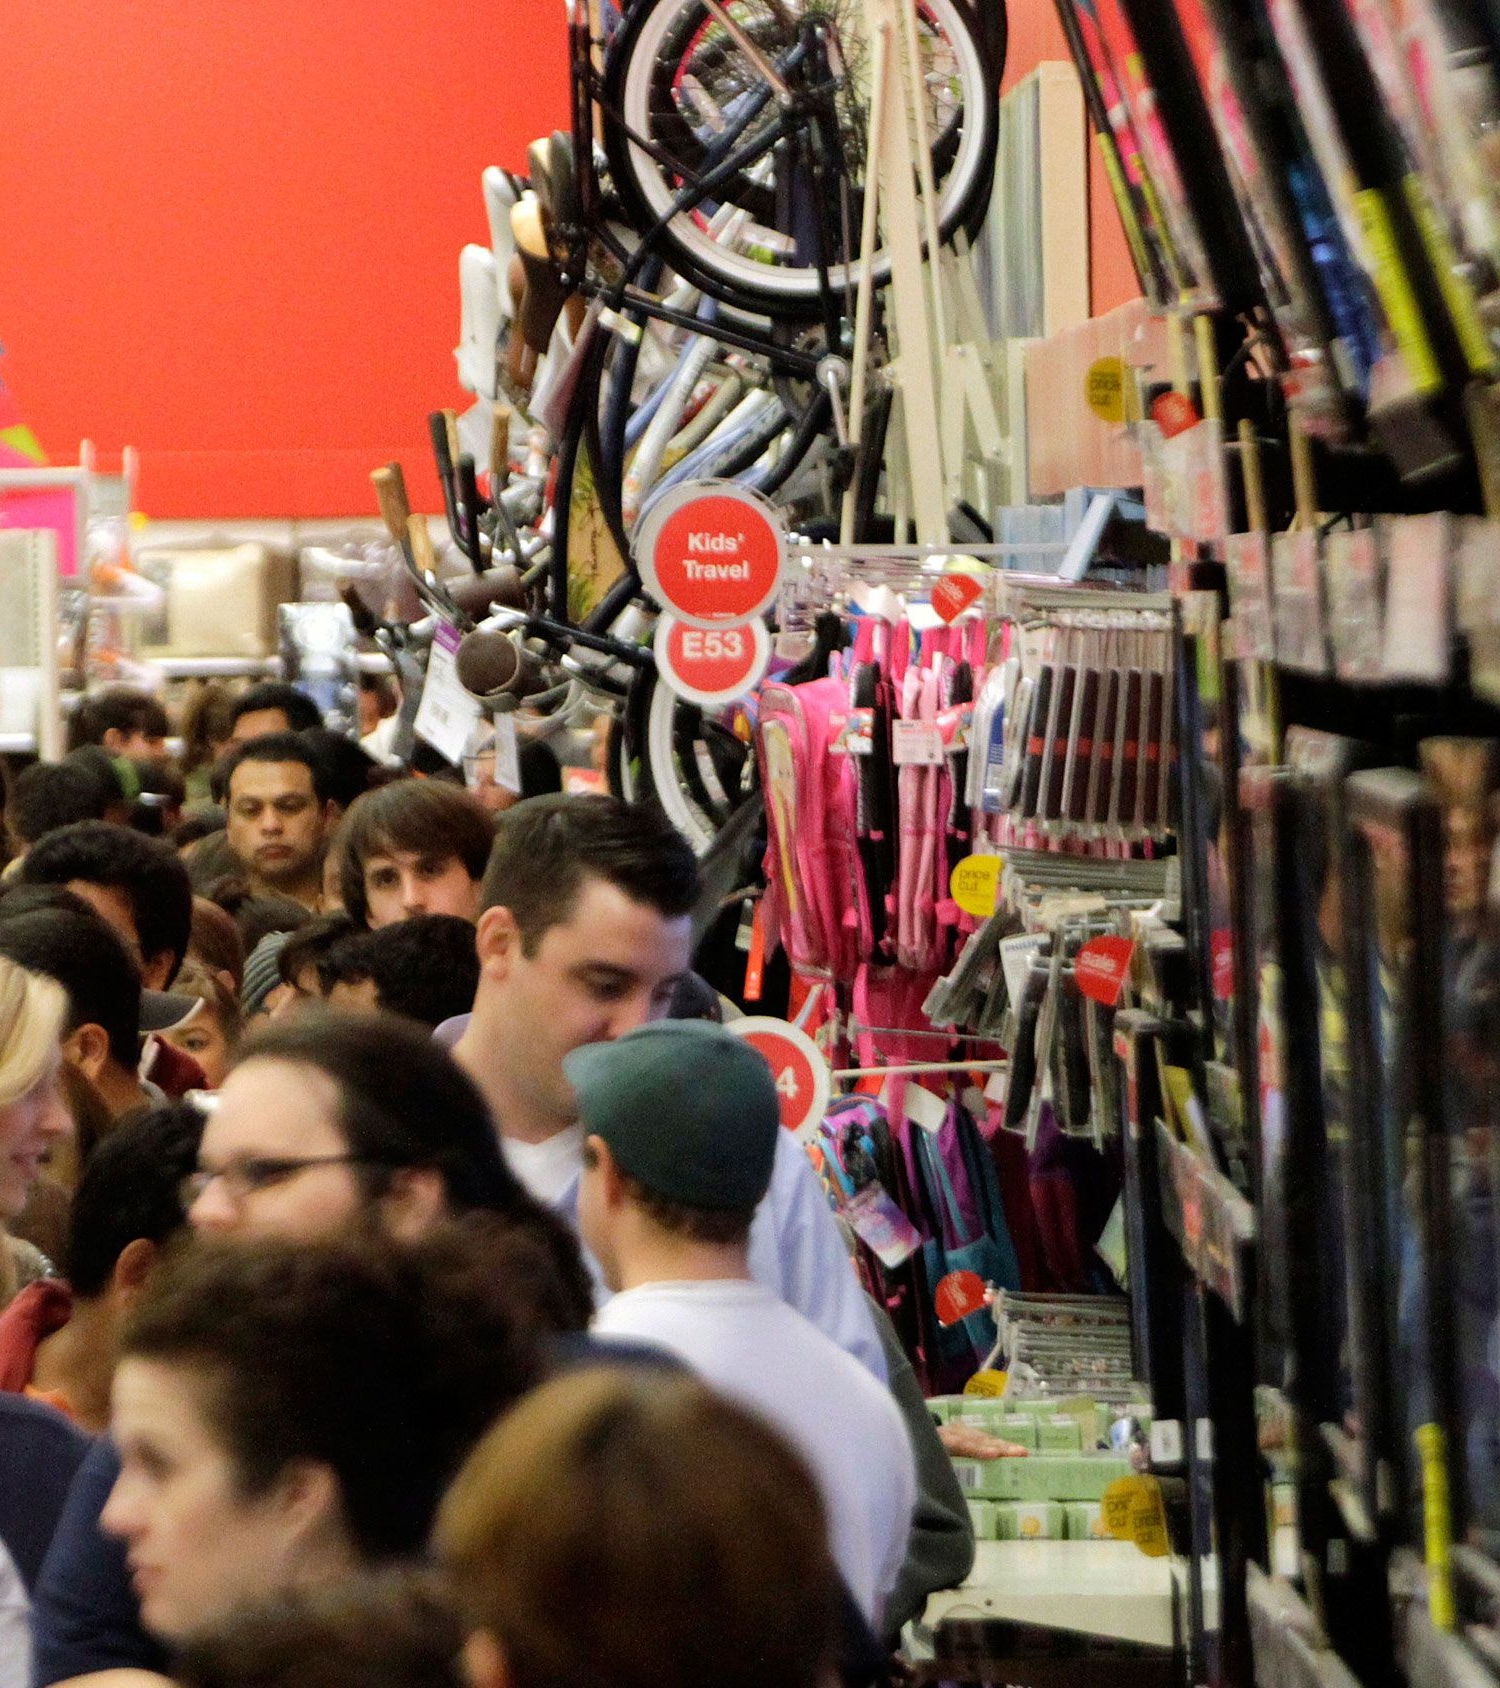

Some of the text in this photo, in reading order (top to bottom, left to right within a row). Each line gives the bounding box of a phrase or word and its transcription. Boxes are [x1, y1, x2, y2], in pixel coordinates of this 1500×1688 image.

[688, 532, 746, 552] Kids'
[682, 559, 750, 579] Travel
[682, 630, 744, 660] E53
[959, 870, 990, 880] price
[958, 881, 978, 891] cut
[1081, 950, 1116, 972] Sale
